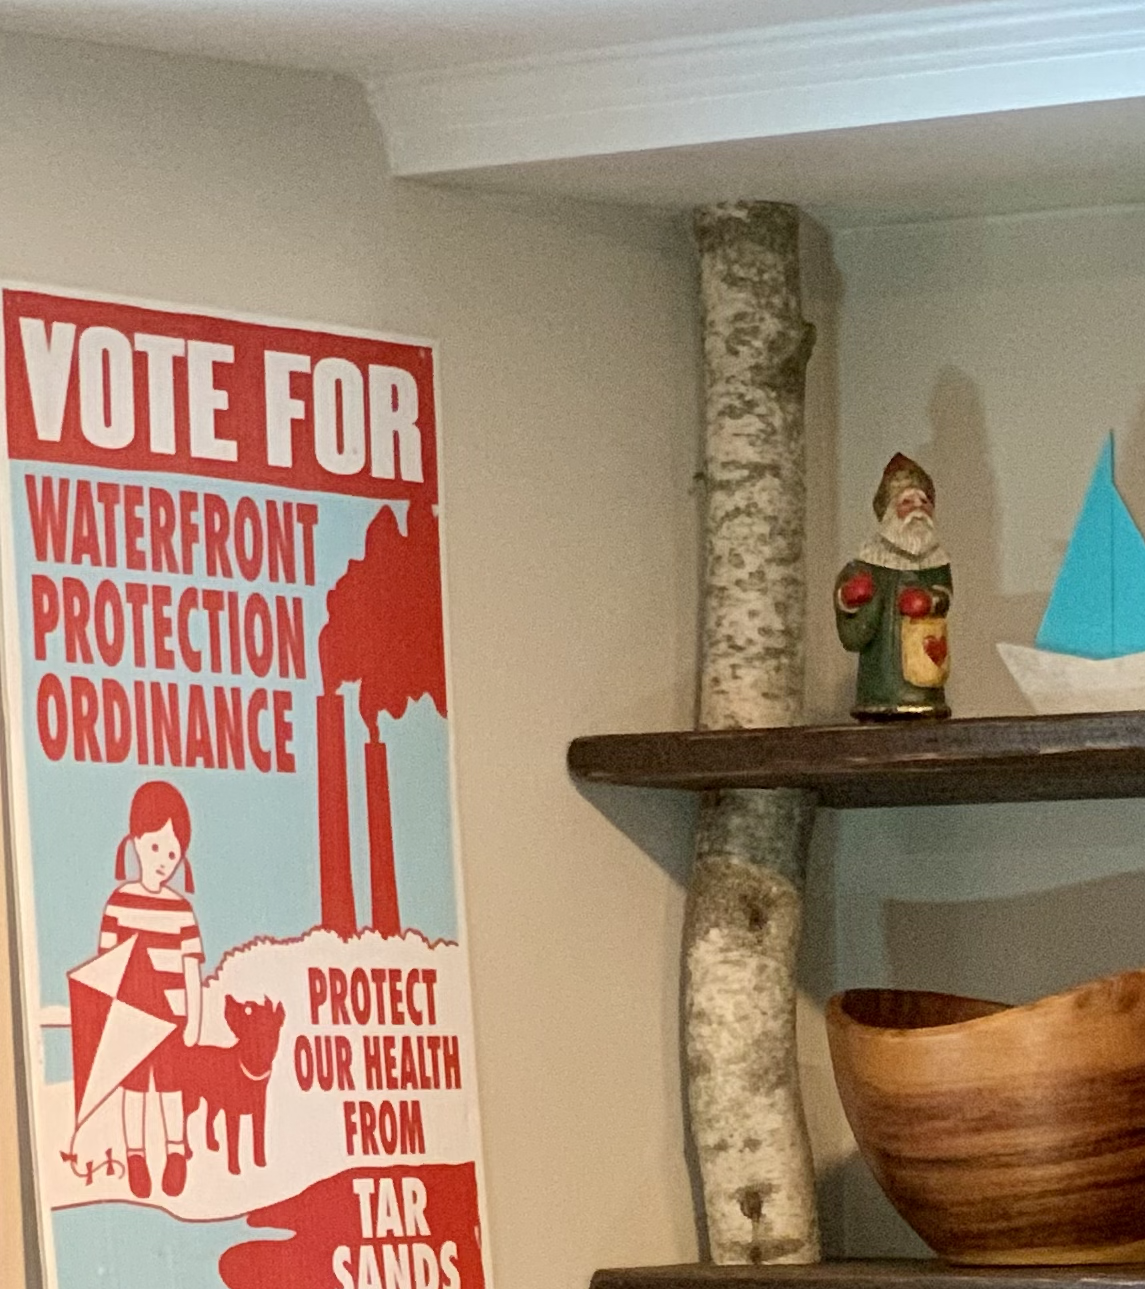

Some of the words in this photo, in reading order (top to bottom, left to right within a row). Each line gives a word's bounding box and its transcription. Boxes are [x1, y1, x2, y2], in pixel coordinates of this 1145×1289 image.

[20, 316, 238, 462] VOTE
[264, 350, 424, 483] FOR
[25, 474, 319, 586] WATERFRONT
[31, 574, 306, 680] PROTECTION
[37, 673, 296, 773] ORDINANCE
[308, 967, 437, 1026] PROTECT
[294, 1035, 353, 1092] OUR
[364, 1035, 462, 1090] HEALTH
[344, 1100, 426, 1156] FROM
[352, 1177, 430, 1239] TAR
